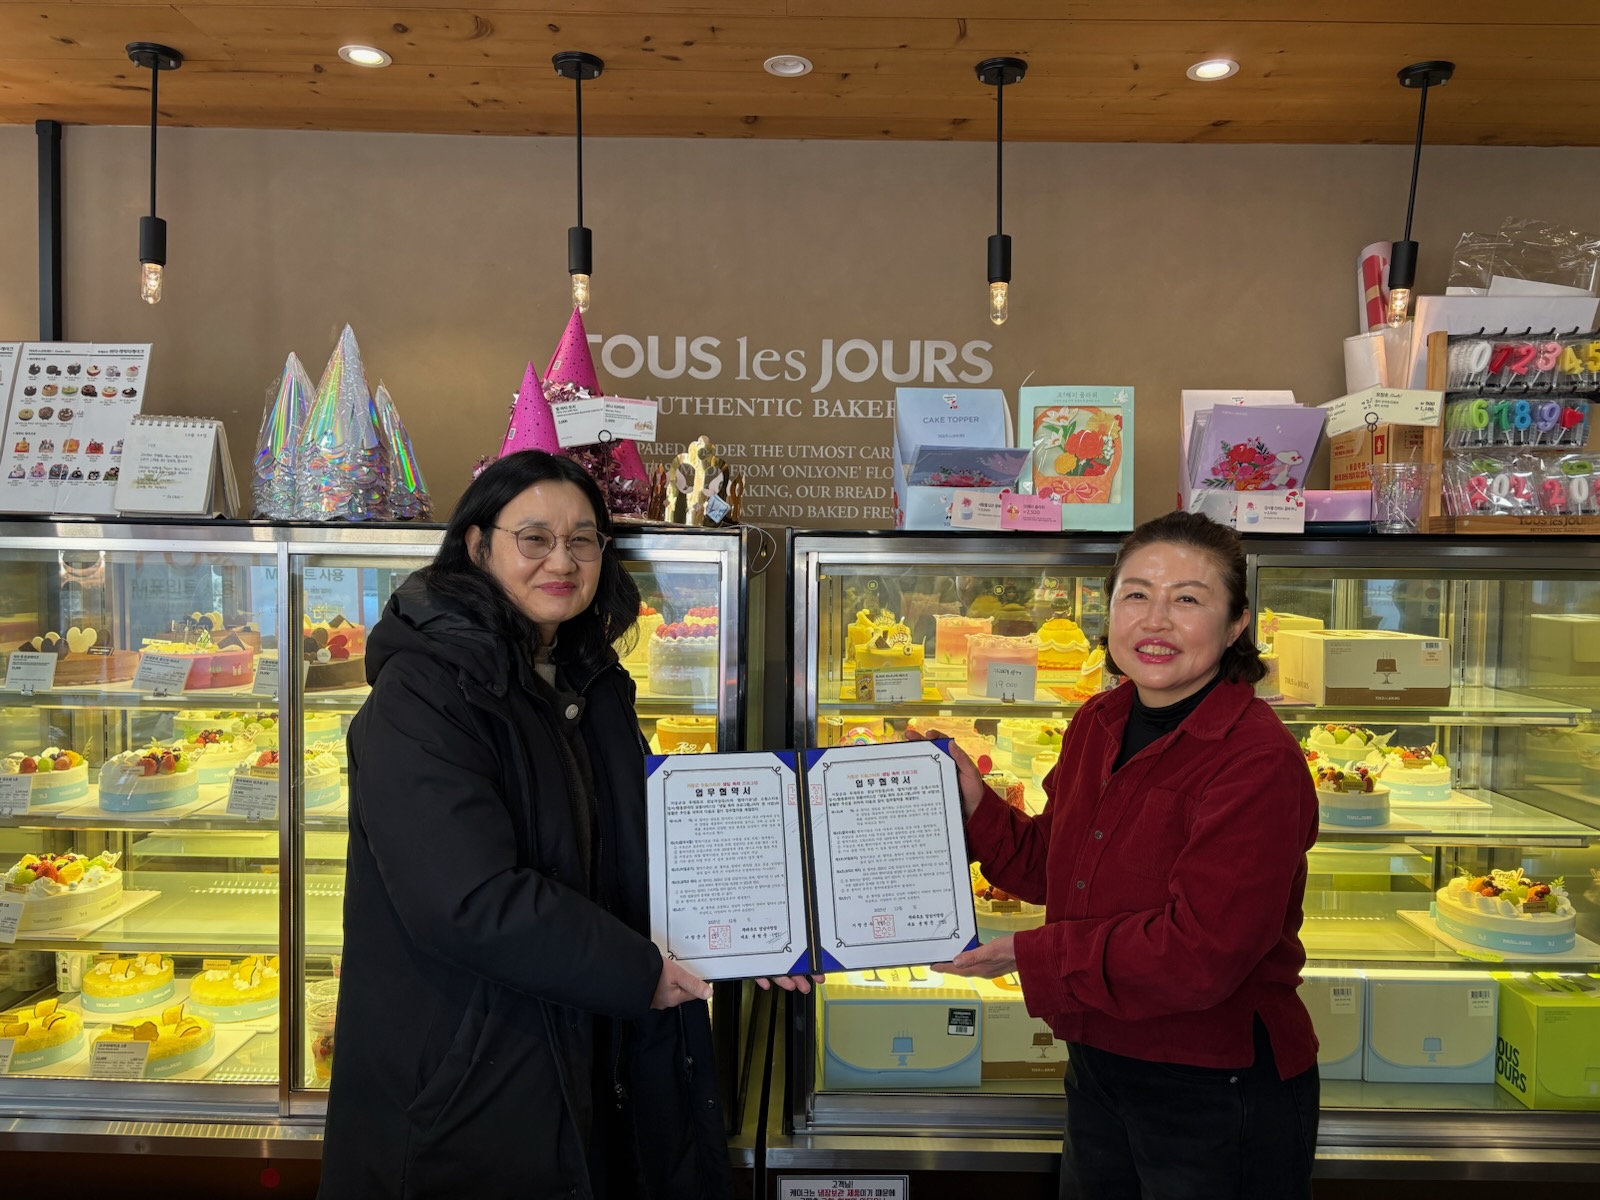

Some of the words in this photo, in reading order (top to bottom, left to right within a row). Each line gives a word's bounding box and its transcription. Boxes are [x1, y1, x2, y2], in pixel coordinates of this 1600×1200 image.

[736, 336, 807, 381] les
[810, 339, 993, 393] JOURS
[644, 396, 802, 417] UTHENTIC
[751, 445, 784, 458] THE
[787, 446, 855, 459] UTMOST
[730, 465, 774, 478] FROM
[779, 465, 861, 479] 'ONLYONE'
[796, 486, 831, 499] OUR
[835, 486, 886, 499] BREAD
[769, 505, 802, 518] AND
[806, 505, 859, 519] BAKED
[320, 568, 344, 582] 사용
[832, 1180, 854, 1188] 고객님!
[790, 1189, 815, 1197] 케이크는
[817, 1189, 845, 1197] 냉장보관
[847, 1189, 873, 1197] 제품이기
[875, 1189, 896, 1197] 때문에
